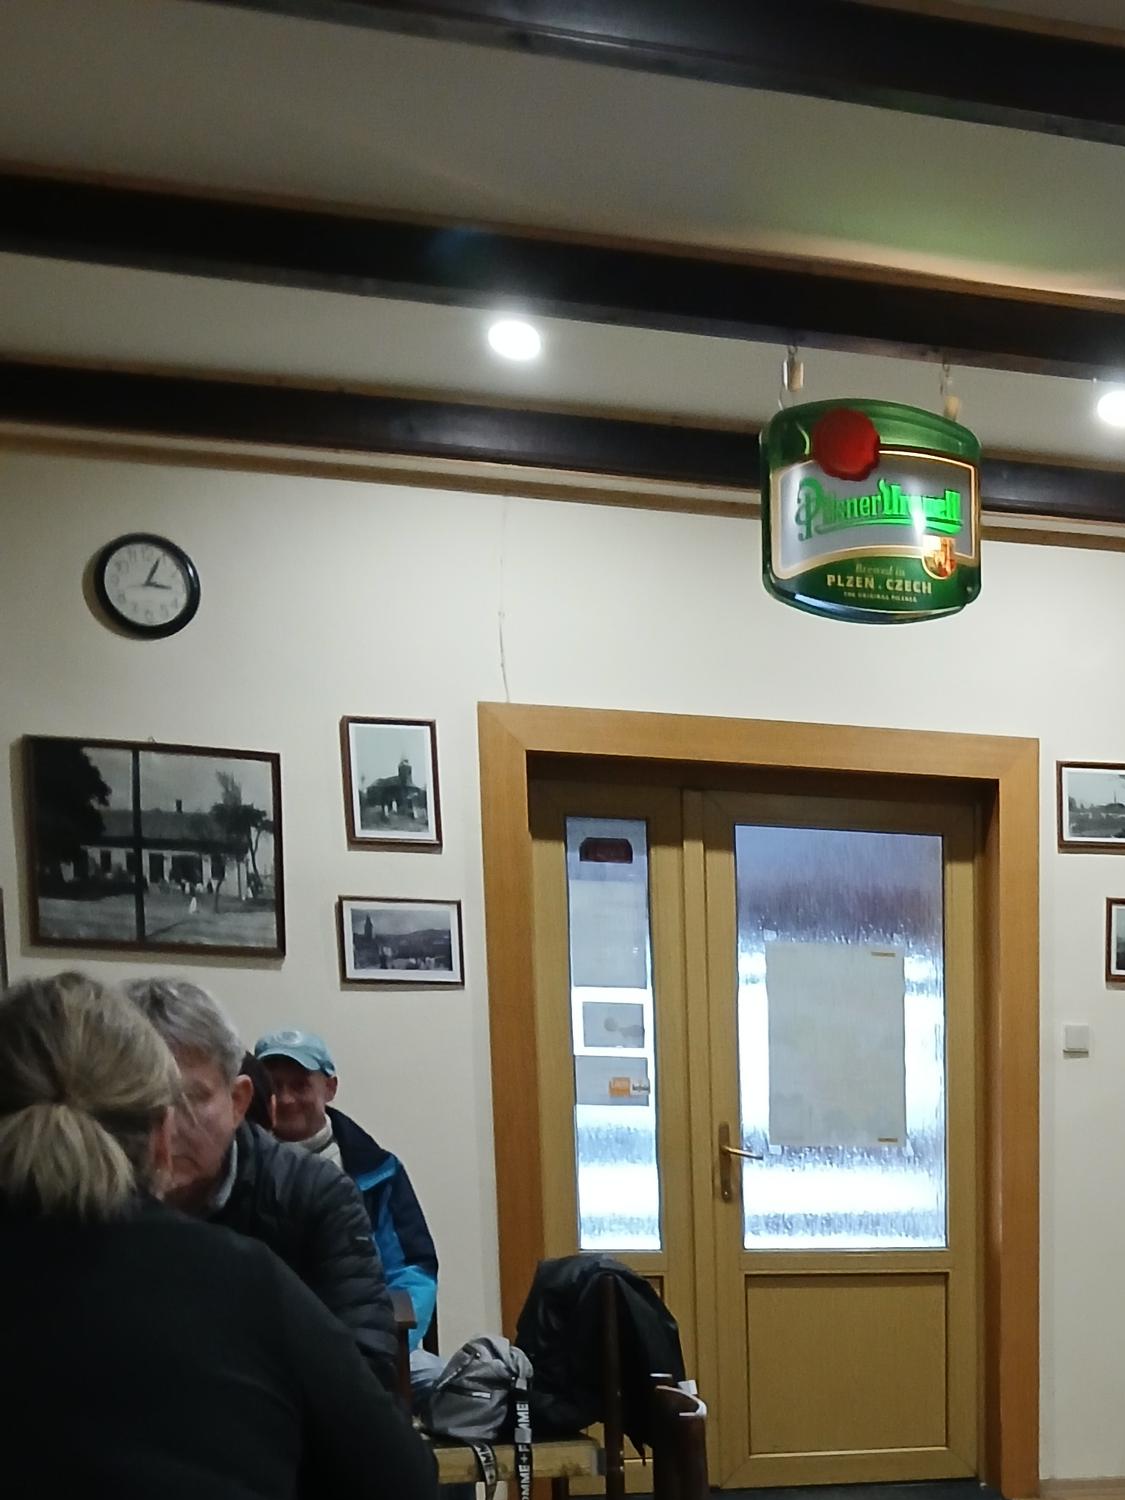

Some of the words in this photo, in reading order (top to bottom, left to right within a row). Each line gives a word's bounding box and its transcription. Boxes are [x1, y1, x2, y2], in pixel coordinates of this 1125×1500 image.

[878, 478, 961, 522] Urell
[886, 579, 932, 594] CZECH
[516, 1402, 531, 1452] FMME
